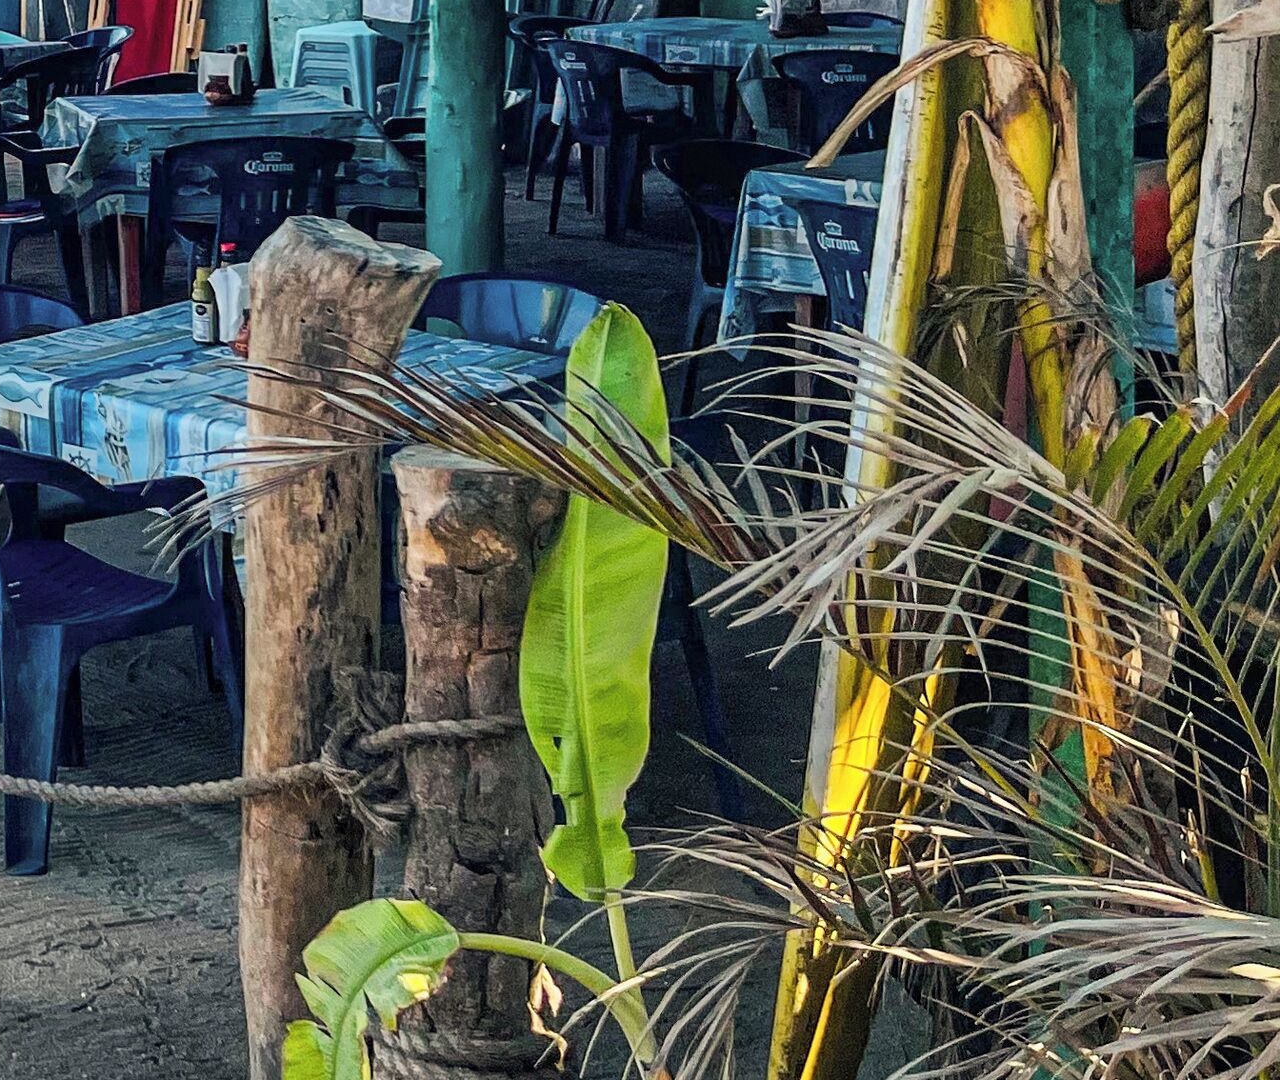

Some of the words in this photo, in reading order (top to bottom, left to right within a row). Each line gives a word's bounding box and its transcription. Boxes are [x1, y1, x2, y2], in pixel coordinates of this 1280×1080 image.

[821, 71, 867, 84] Corona
[244, 160, 294, 175] Corona
[816, 231, 862, 255] Corona
